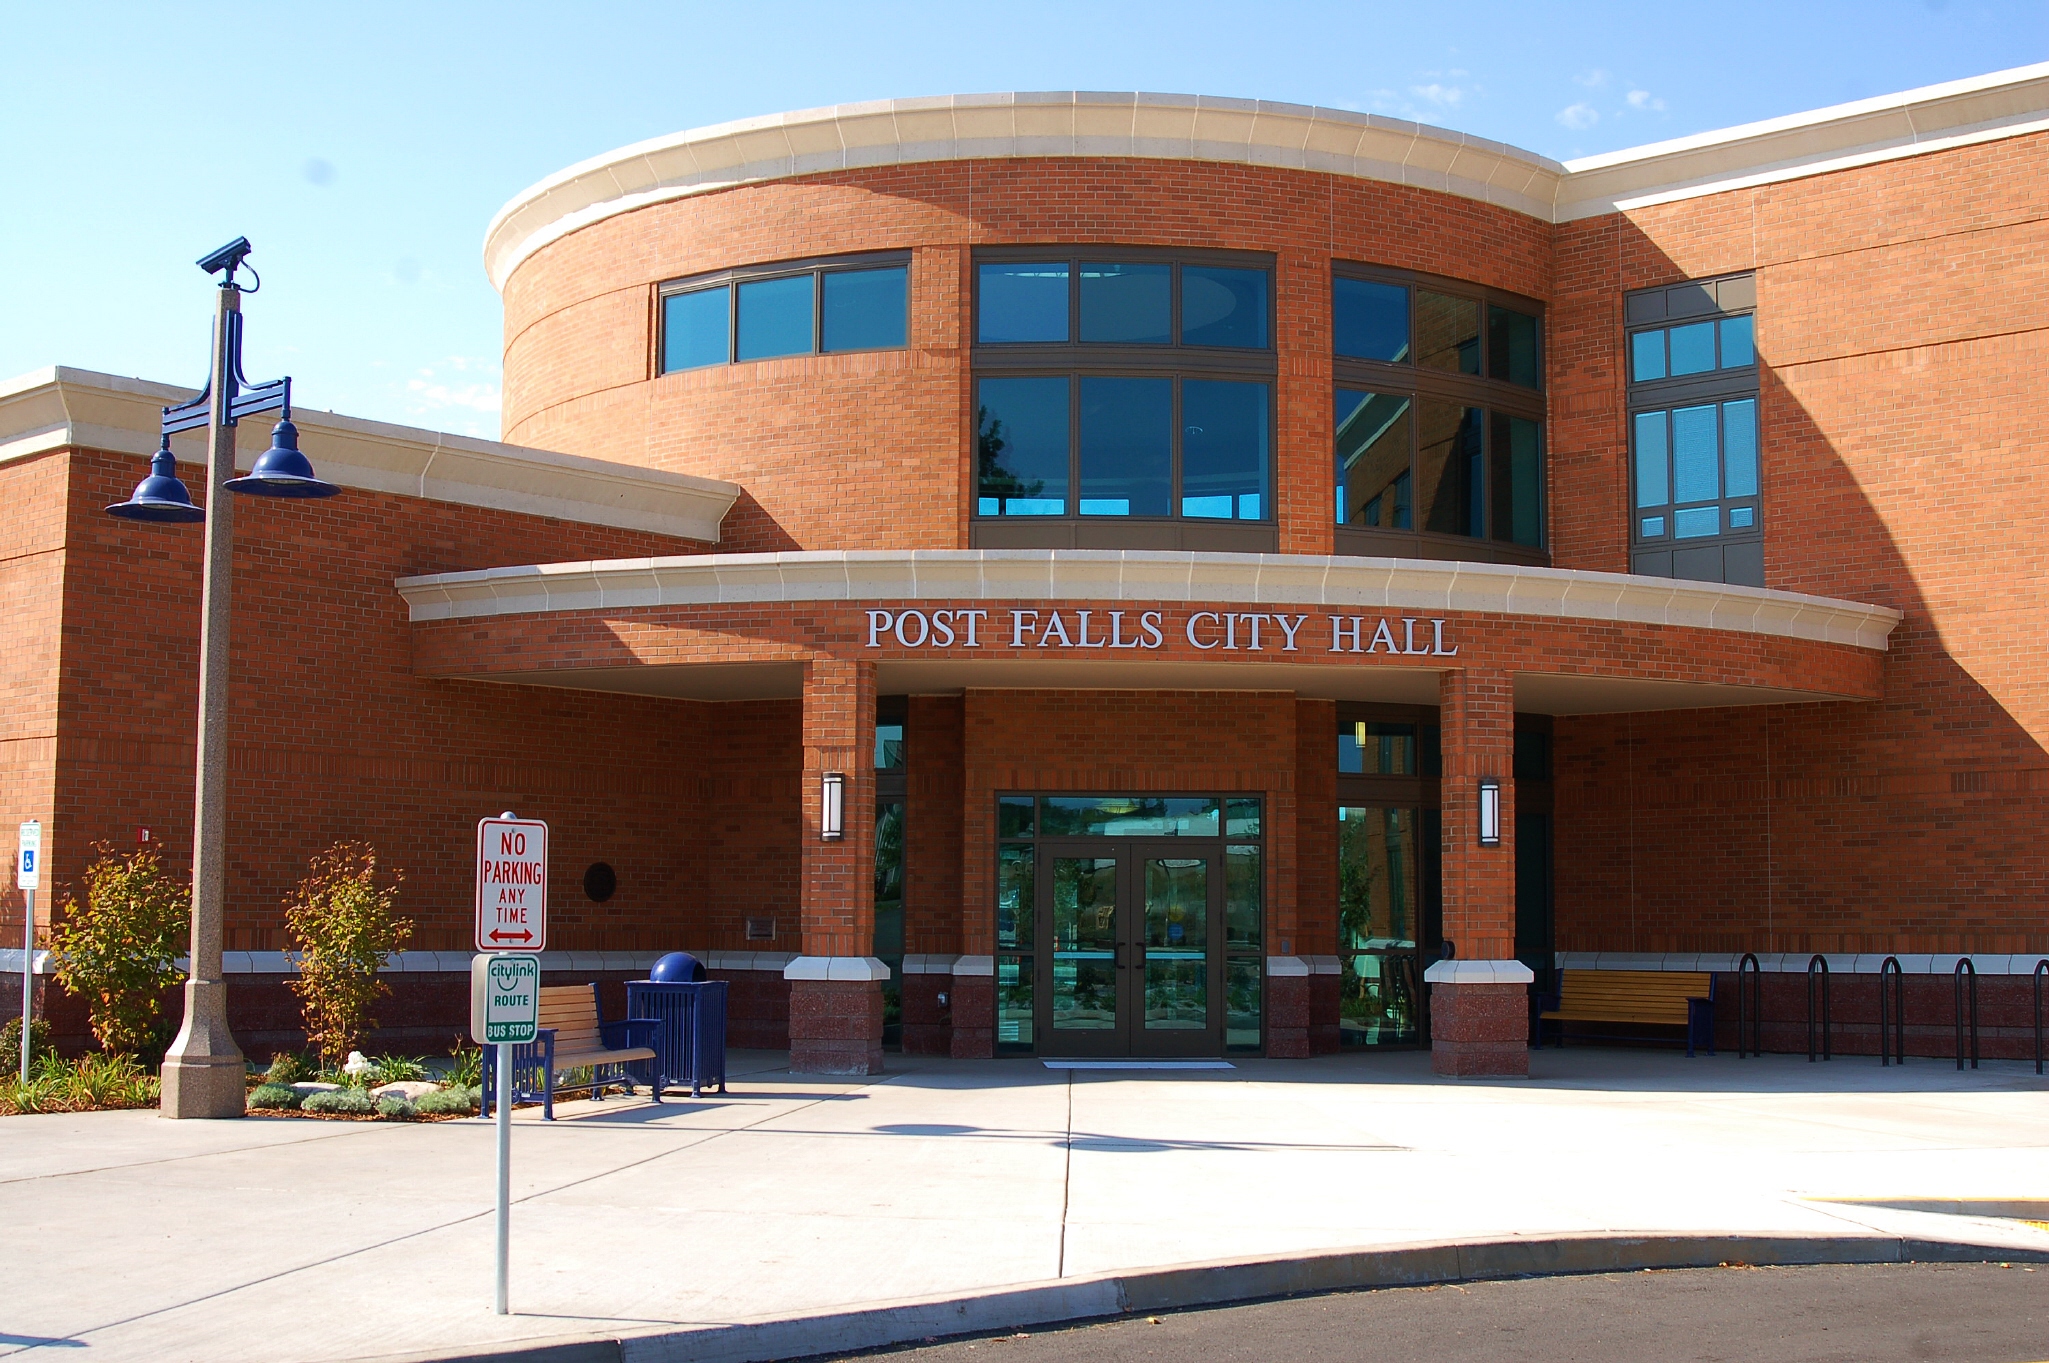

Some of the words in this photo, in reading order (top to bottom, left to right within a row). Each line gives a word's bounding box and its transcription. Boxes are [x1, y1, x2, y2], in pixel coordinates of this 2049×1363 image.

[865, 609, 987, 648] POST
[1009, 610, 1163, 649] FALLS
[1186, 611, 1308, 651] CITY
[1328, 615, 1458, 656] HALL
[501, 832, 526, 856] NO
[484, 860, 541, 885] PARKING
[499, 888, 525, 904] ANY
[496, 907, 527, 923] TIME
[491, 963, 534, 980] citylink
[494, 995, 529, 1006] ROUTE
[487, 1025, 507, 1038] BUS
[509, 1024, 534, 1037] STOP
